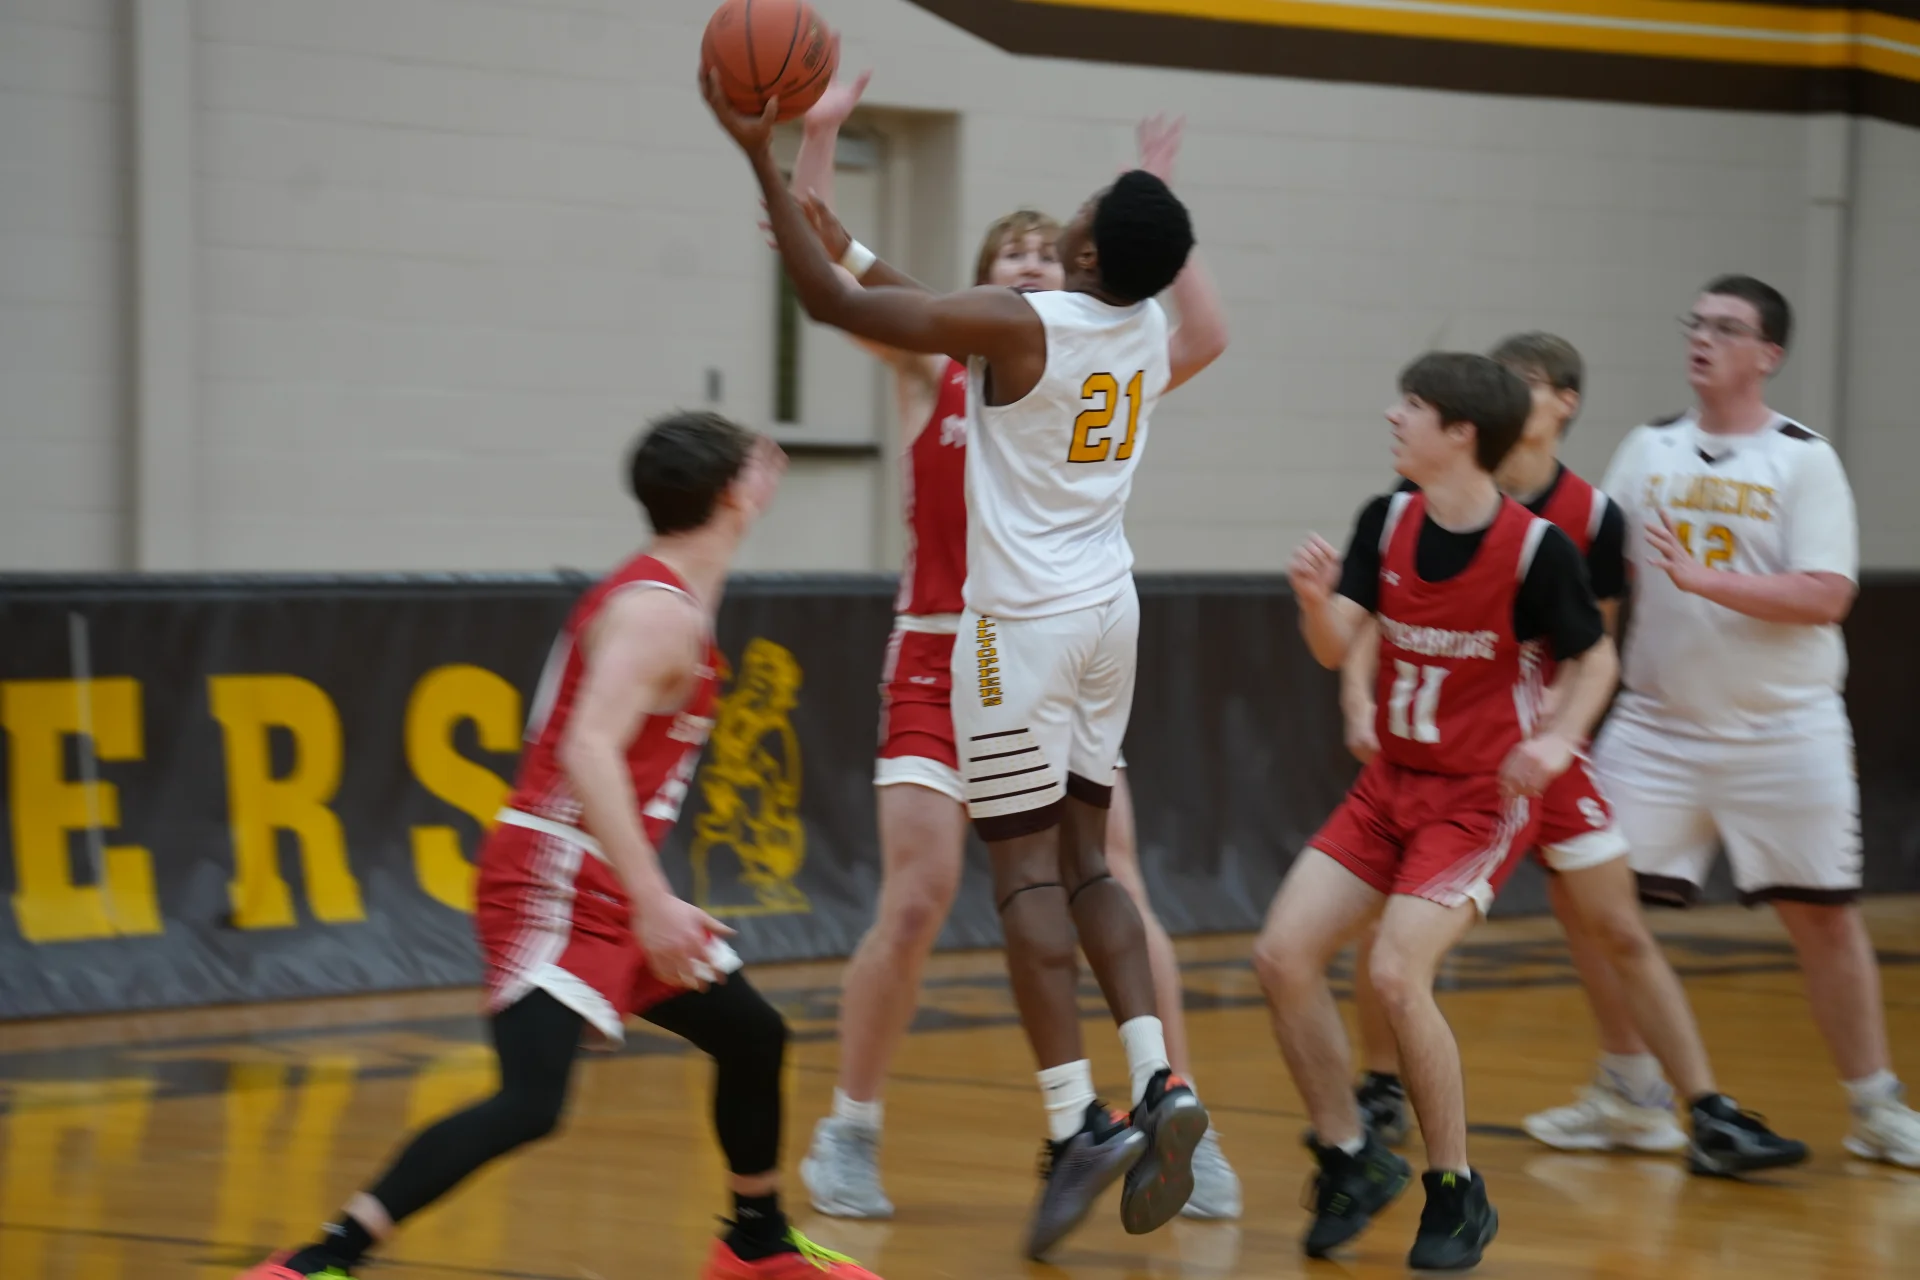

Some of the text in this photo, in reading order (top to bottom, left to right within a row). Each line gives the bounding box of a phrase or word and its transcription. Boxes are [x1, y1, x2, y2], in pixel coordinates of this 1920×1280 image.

[1067, 370, 1146, 463] 21
[1388, 659, 1450, 743] 11
[0, 663, 523, 944] ERS
